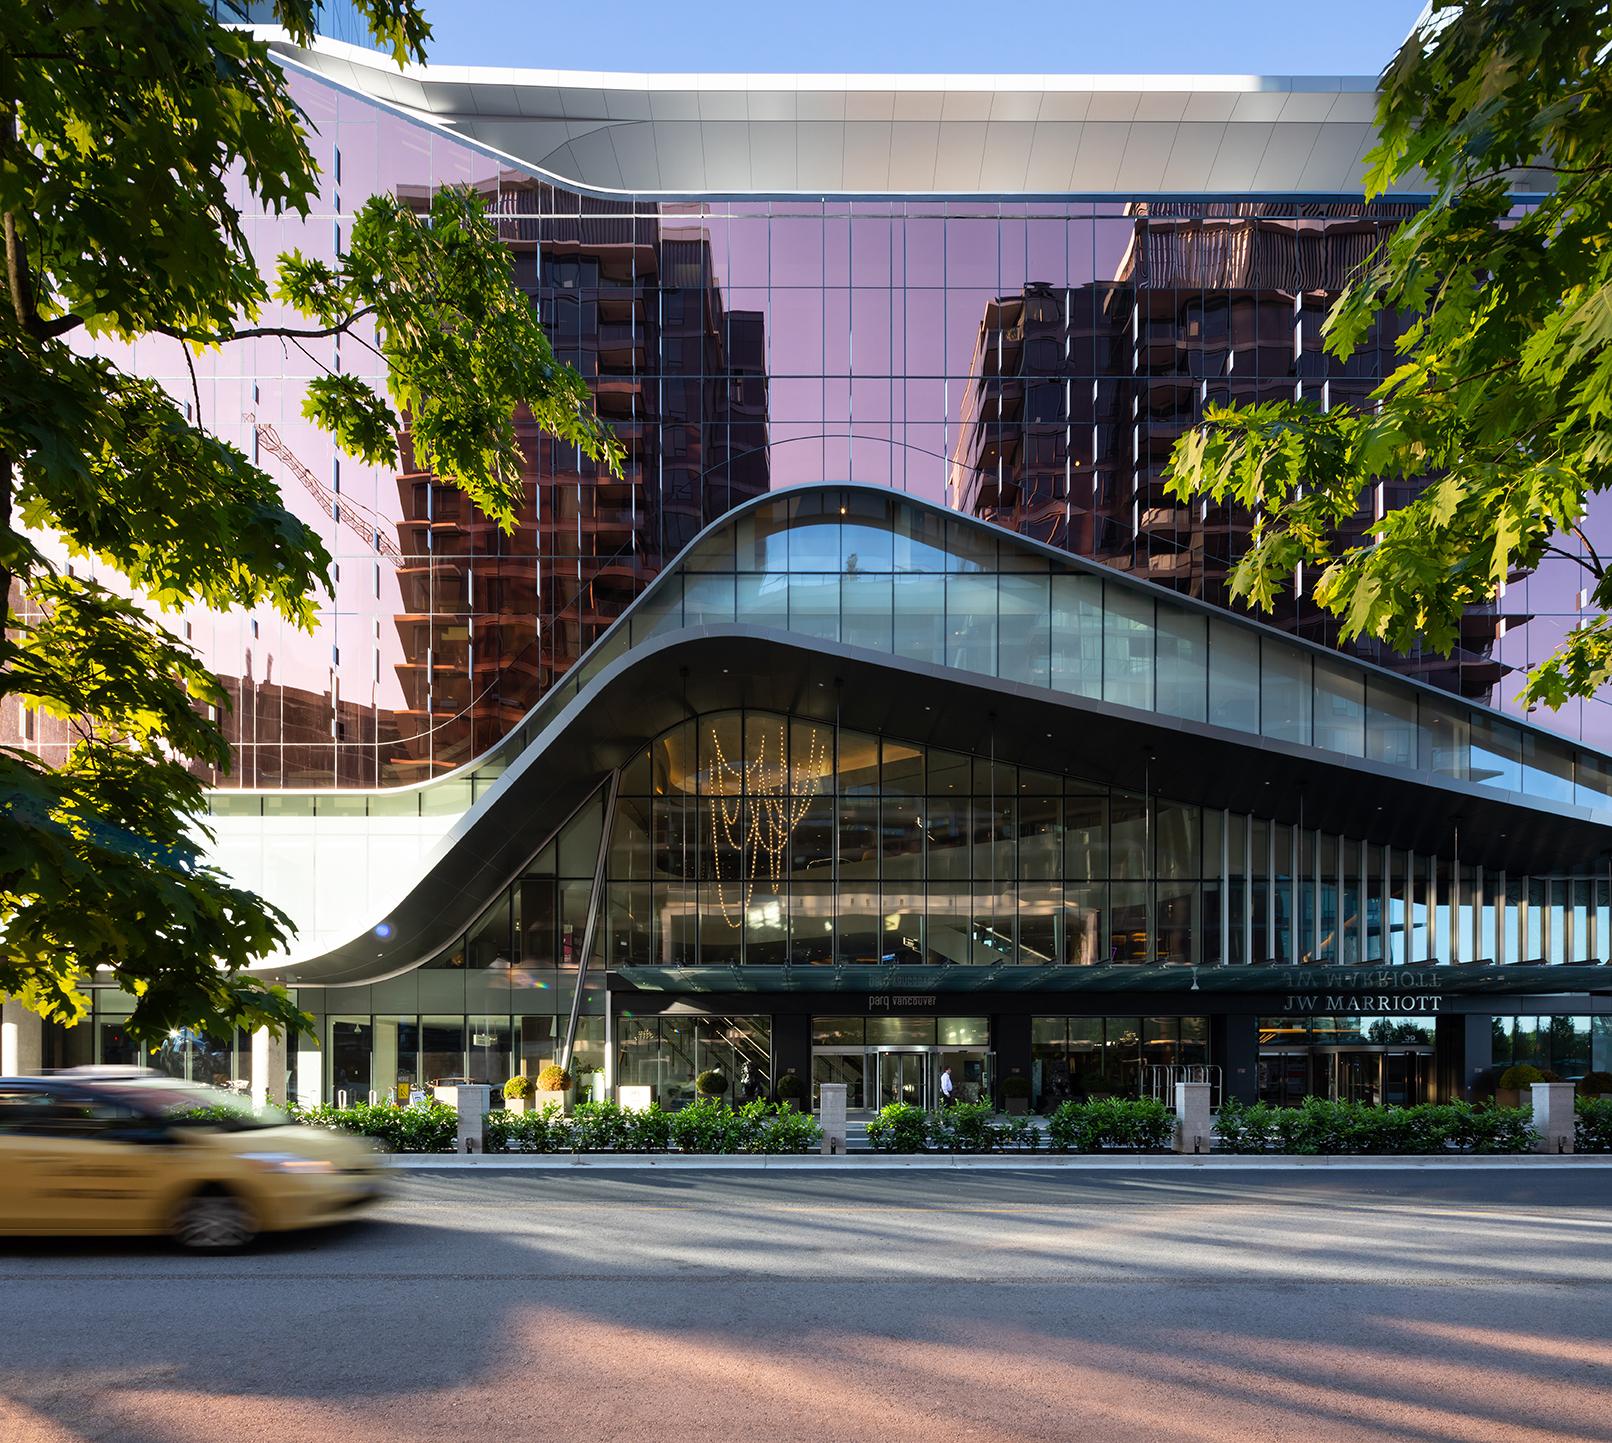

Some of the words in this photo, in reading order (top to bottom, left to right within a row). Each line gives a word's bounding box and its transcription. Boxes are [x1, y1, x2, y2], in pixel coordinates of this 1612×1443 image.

[868, 995, 890, 1011] parq
[892, 995, 937, 1006] vancouver
[1284, 995, 1318, 1011] JW
[1325, 995, 1442, 1011] MARRIOTT
